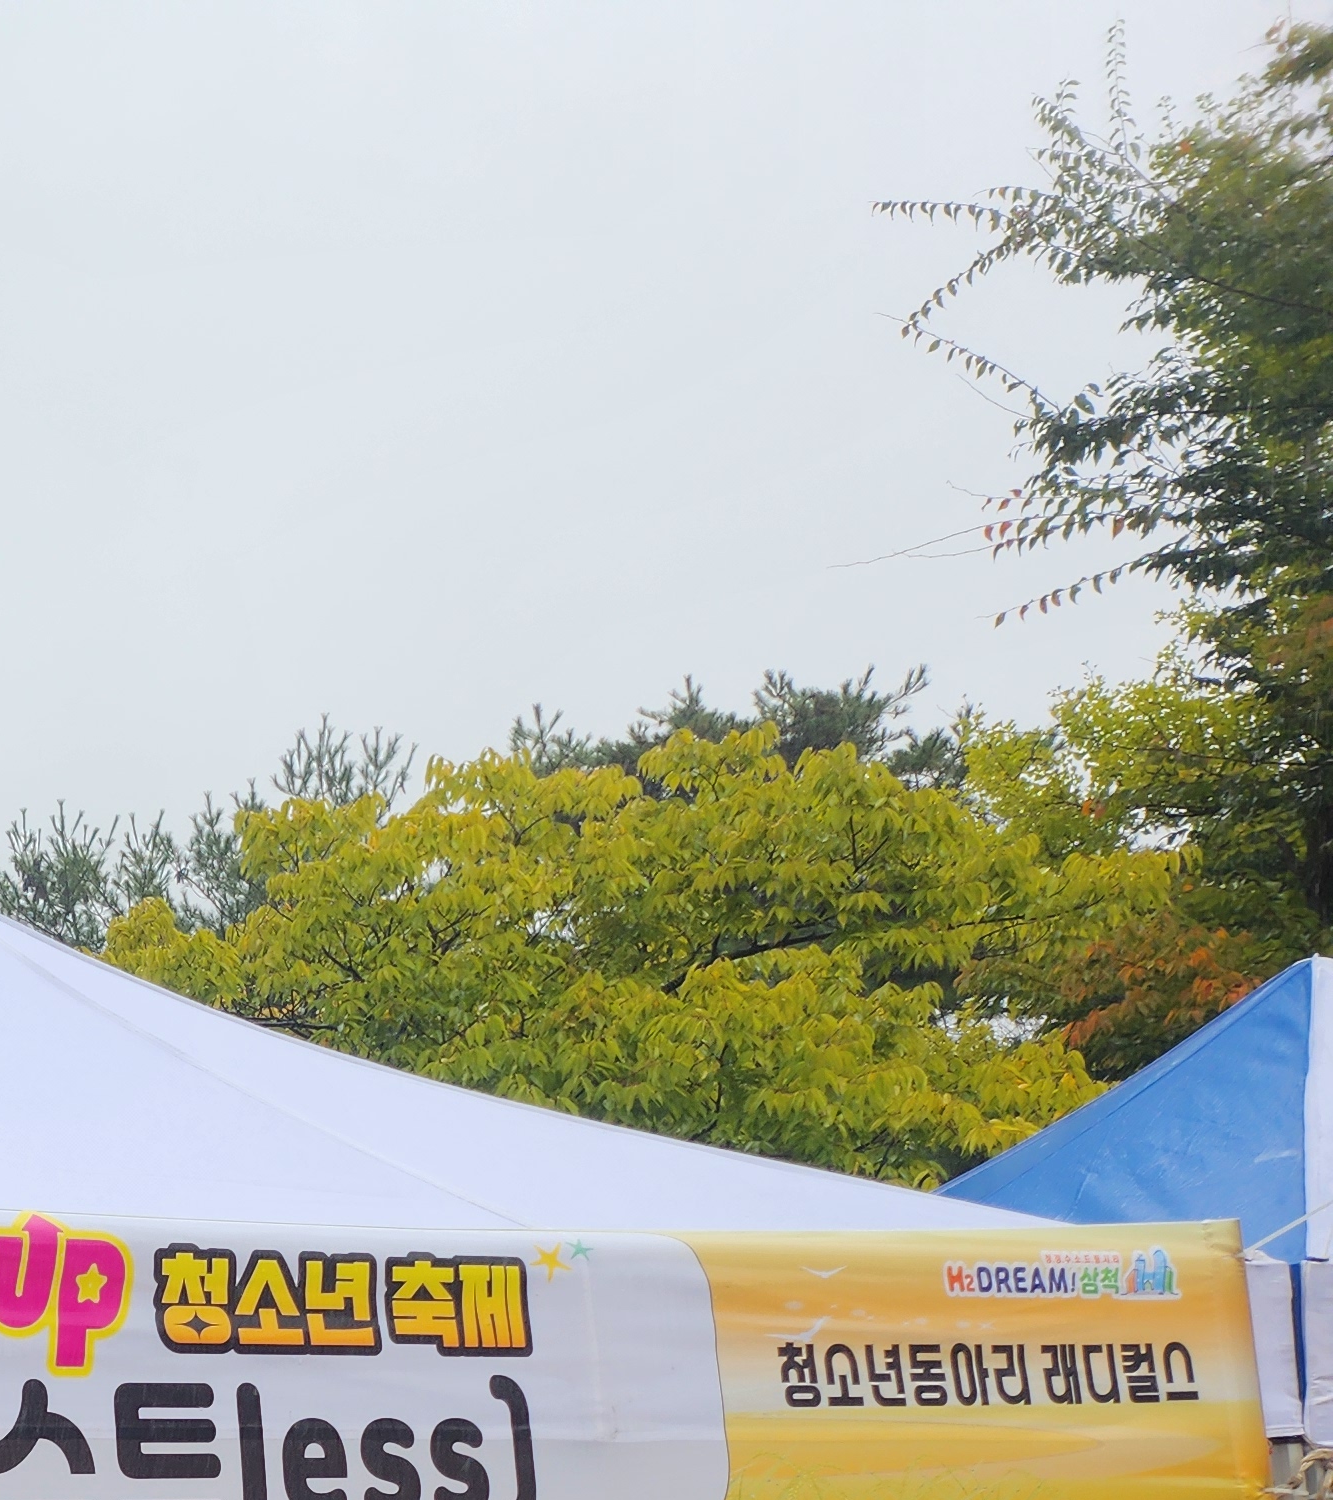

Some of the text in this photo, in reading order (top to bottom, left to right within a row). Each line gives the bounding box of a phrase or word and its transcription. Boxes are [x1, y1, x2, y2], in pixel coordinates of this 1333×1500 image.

[154, 1243, 382, 1356] 청소년
[385, 1251, 533, 1357] 축제
[1079, 1266, 1121, 1295] 삼척
[777, 1340, 1200, 1407] 청소년동아리 래디컬스
